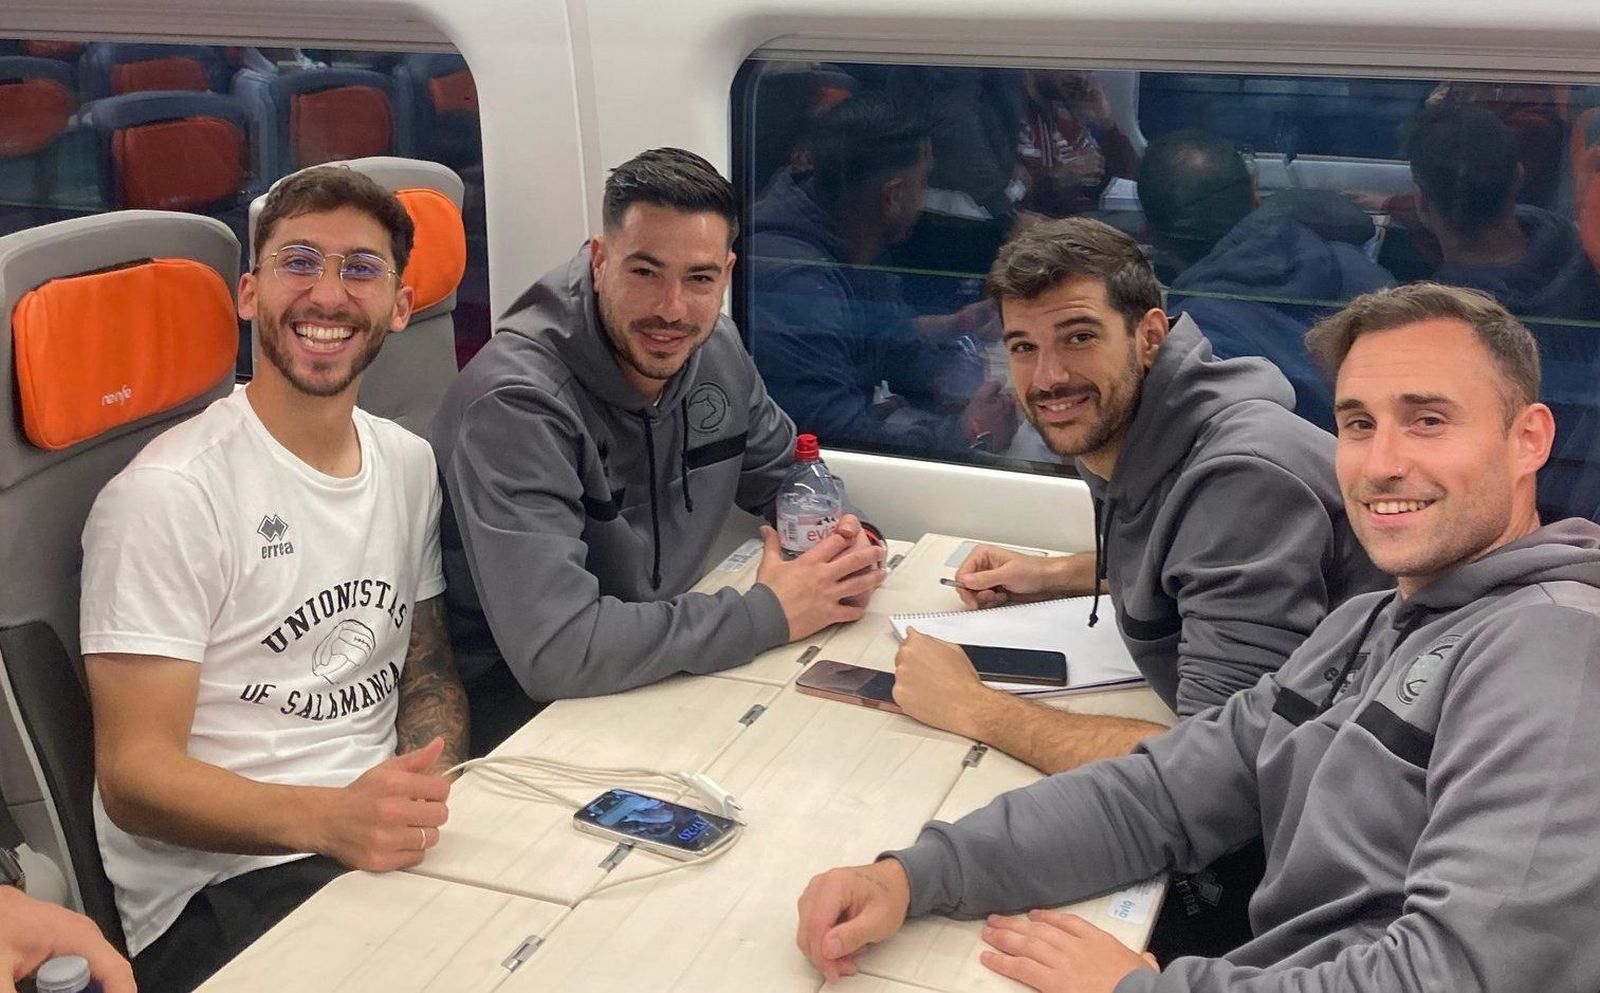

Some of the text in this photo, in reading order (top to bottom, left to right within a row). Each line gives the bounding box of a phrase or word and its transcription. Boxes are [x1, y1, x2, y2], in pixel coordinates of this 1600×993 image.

[101, 384, 132, 407] renfe
[260, 578, 408, 654] UNIONISTAS
[280, 661, 401, 721] SALAMANCA
